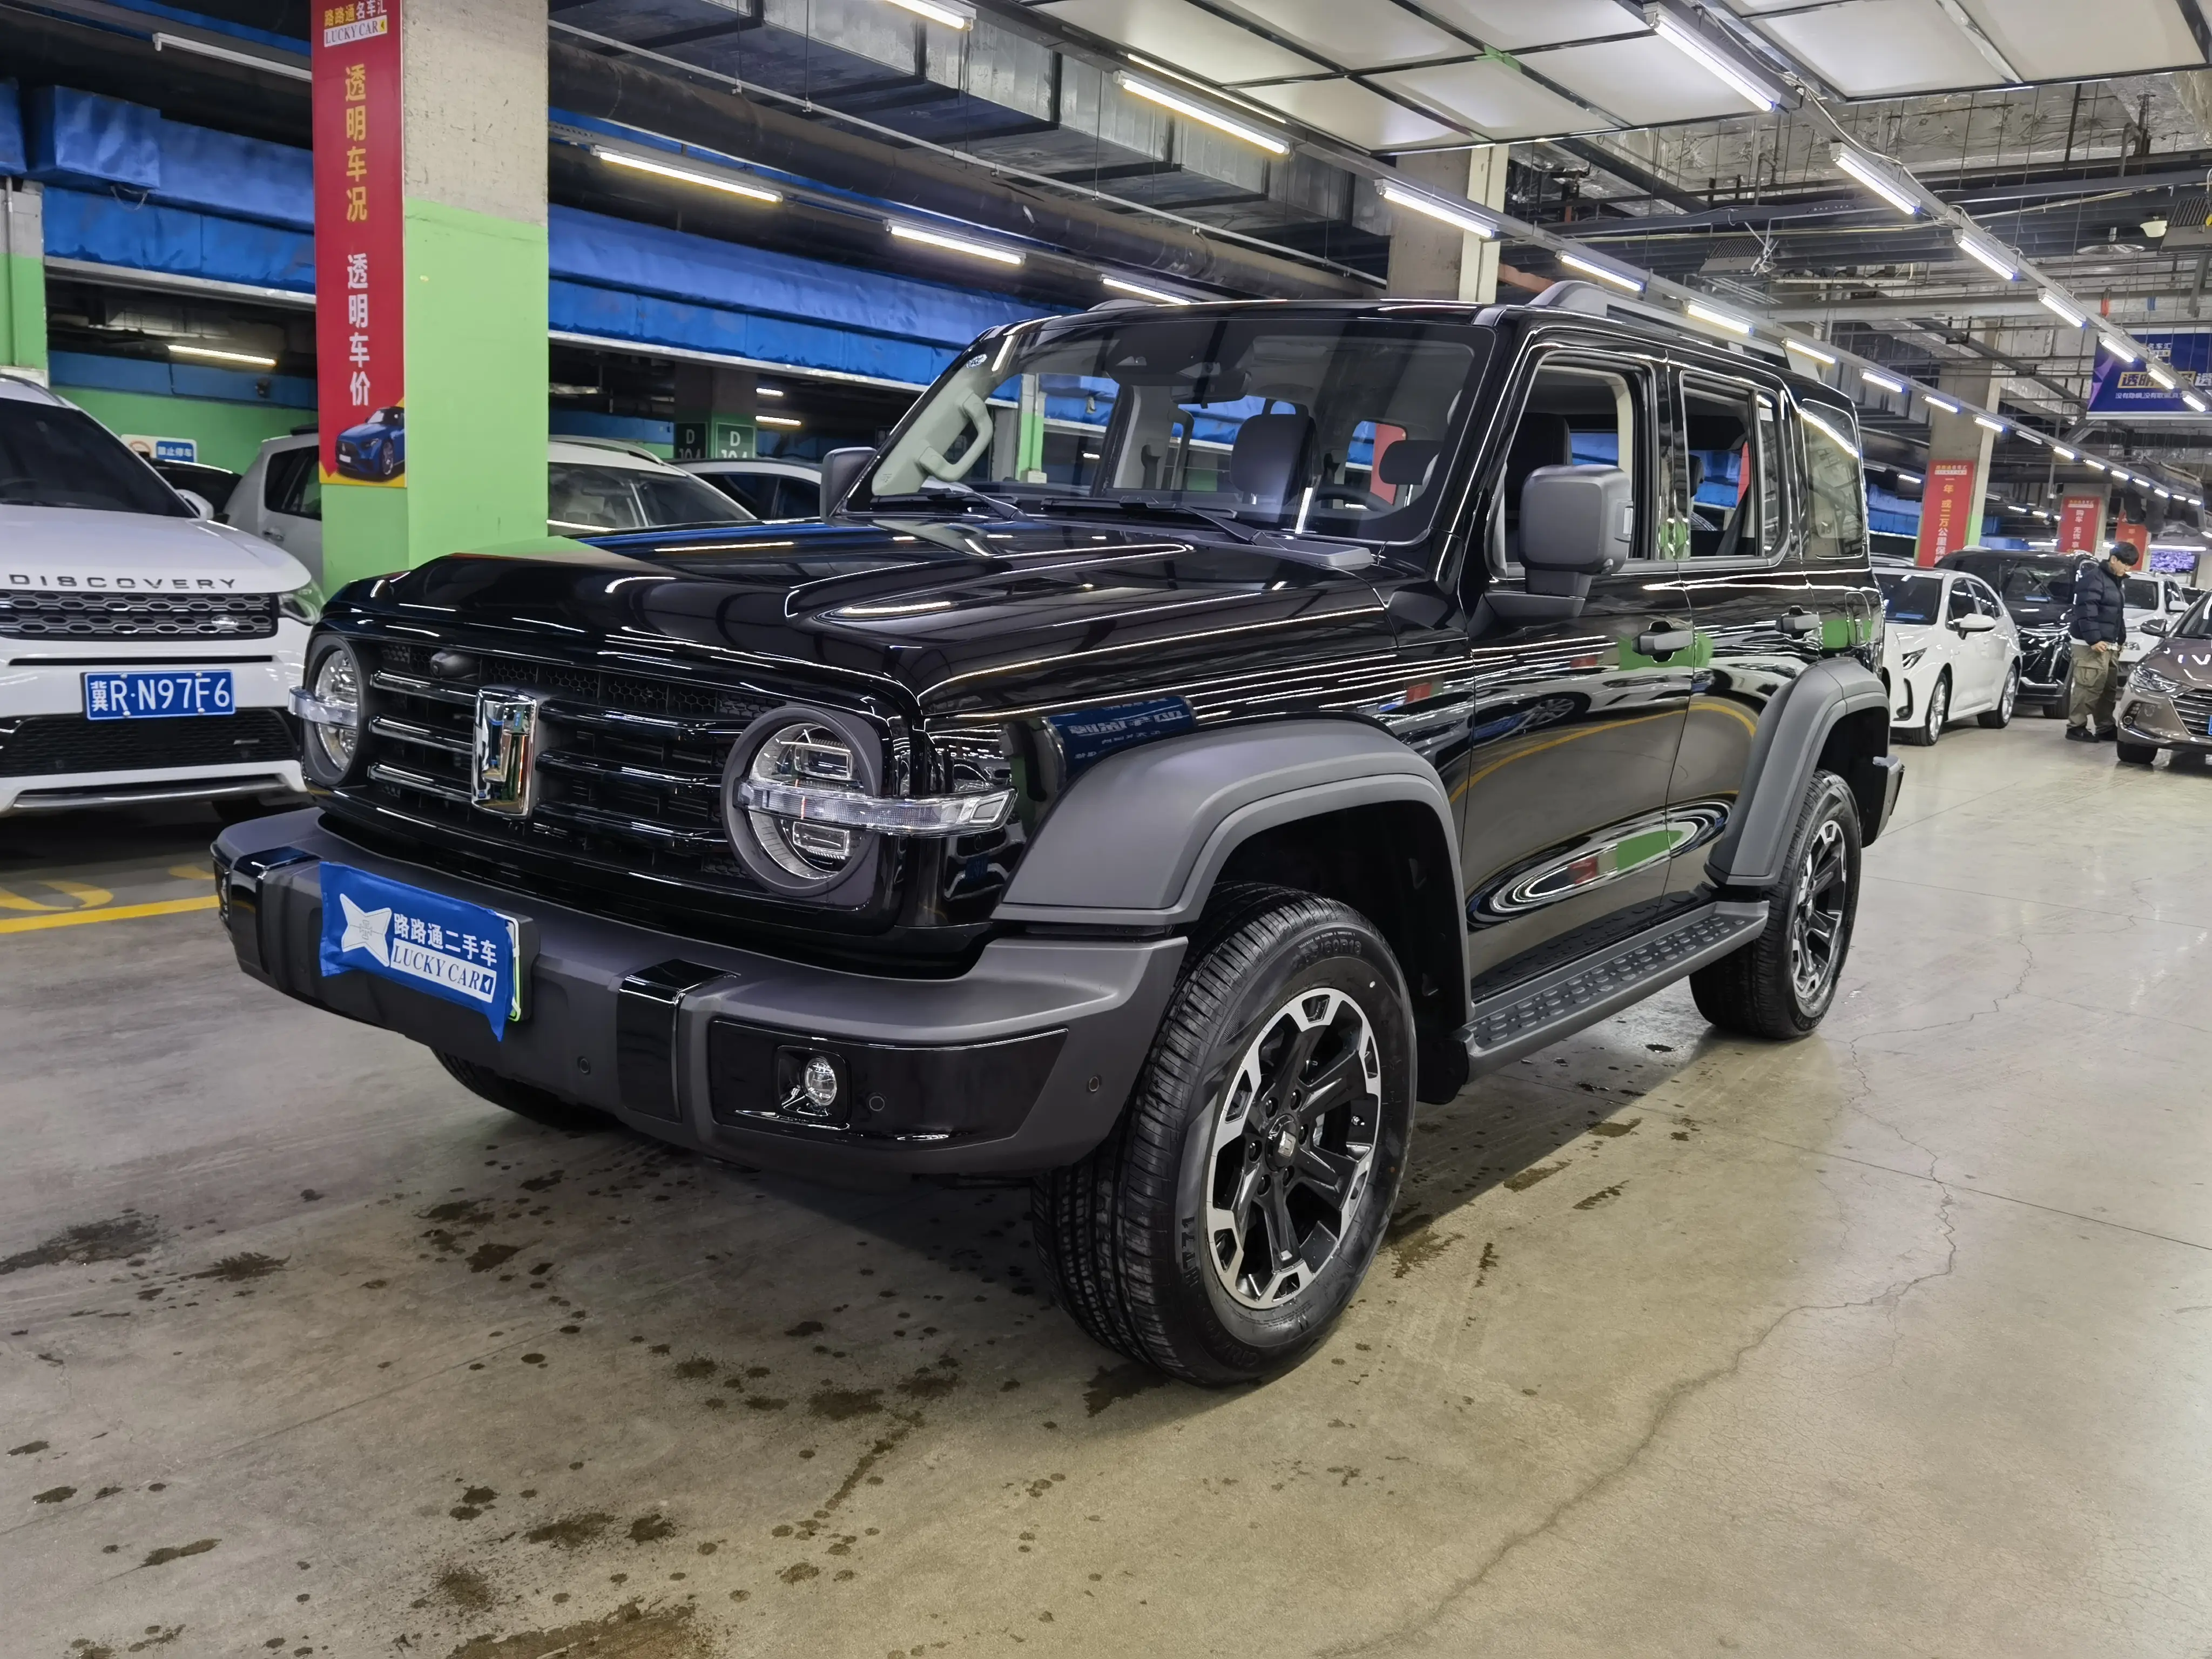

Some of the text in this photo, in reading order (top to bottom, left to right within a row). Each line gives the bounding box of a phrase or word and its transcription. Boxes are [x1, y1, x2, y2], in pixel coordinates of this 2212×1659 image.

[326, 21, 378, 44] LUCKY CAR
[345, 63, 370, 406] 透明车况 透明车价
[686, 429, 695, 444] D
[730, 431, 741, 447] D
[9, 574, 238, 589] DISCOVERY
[90, 678, 231, 712] 冀R·N97F6
[393, 913, 497, 966] 路路通二手车
[393, 946, 480, 990] LUCKY CAR
